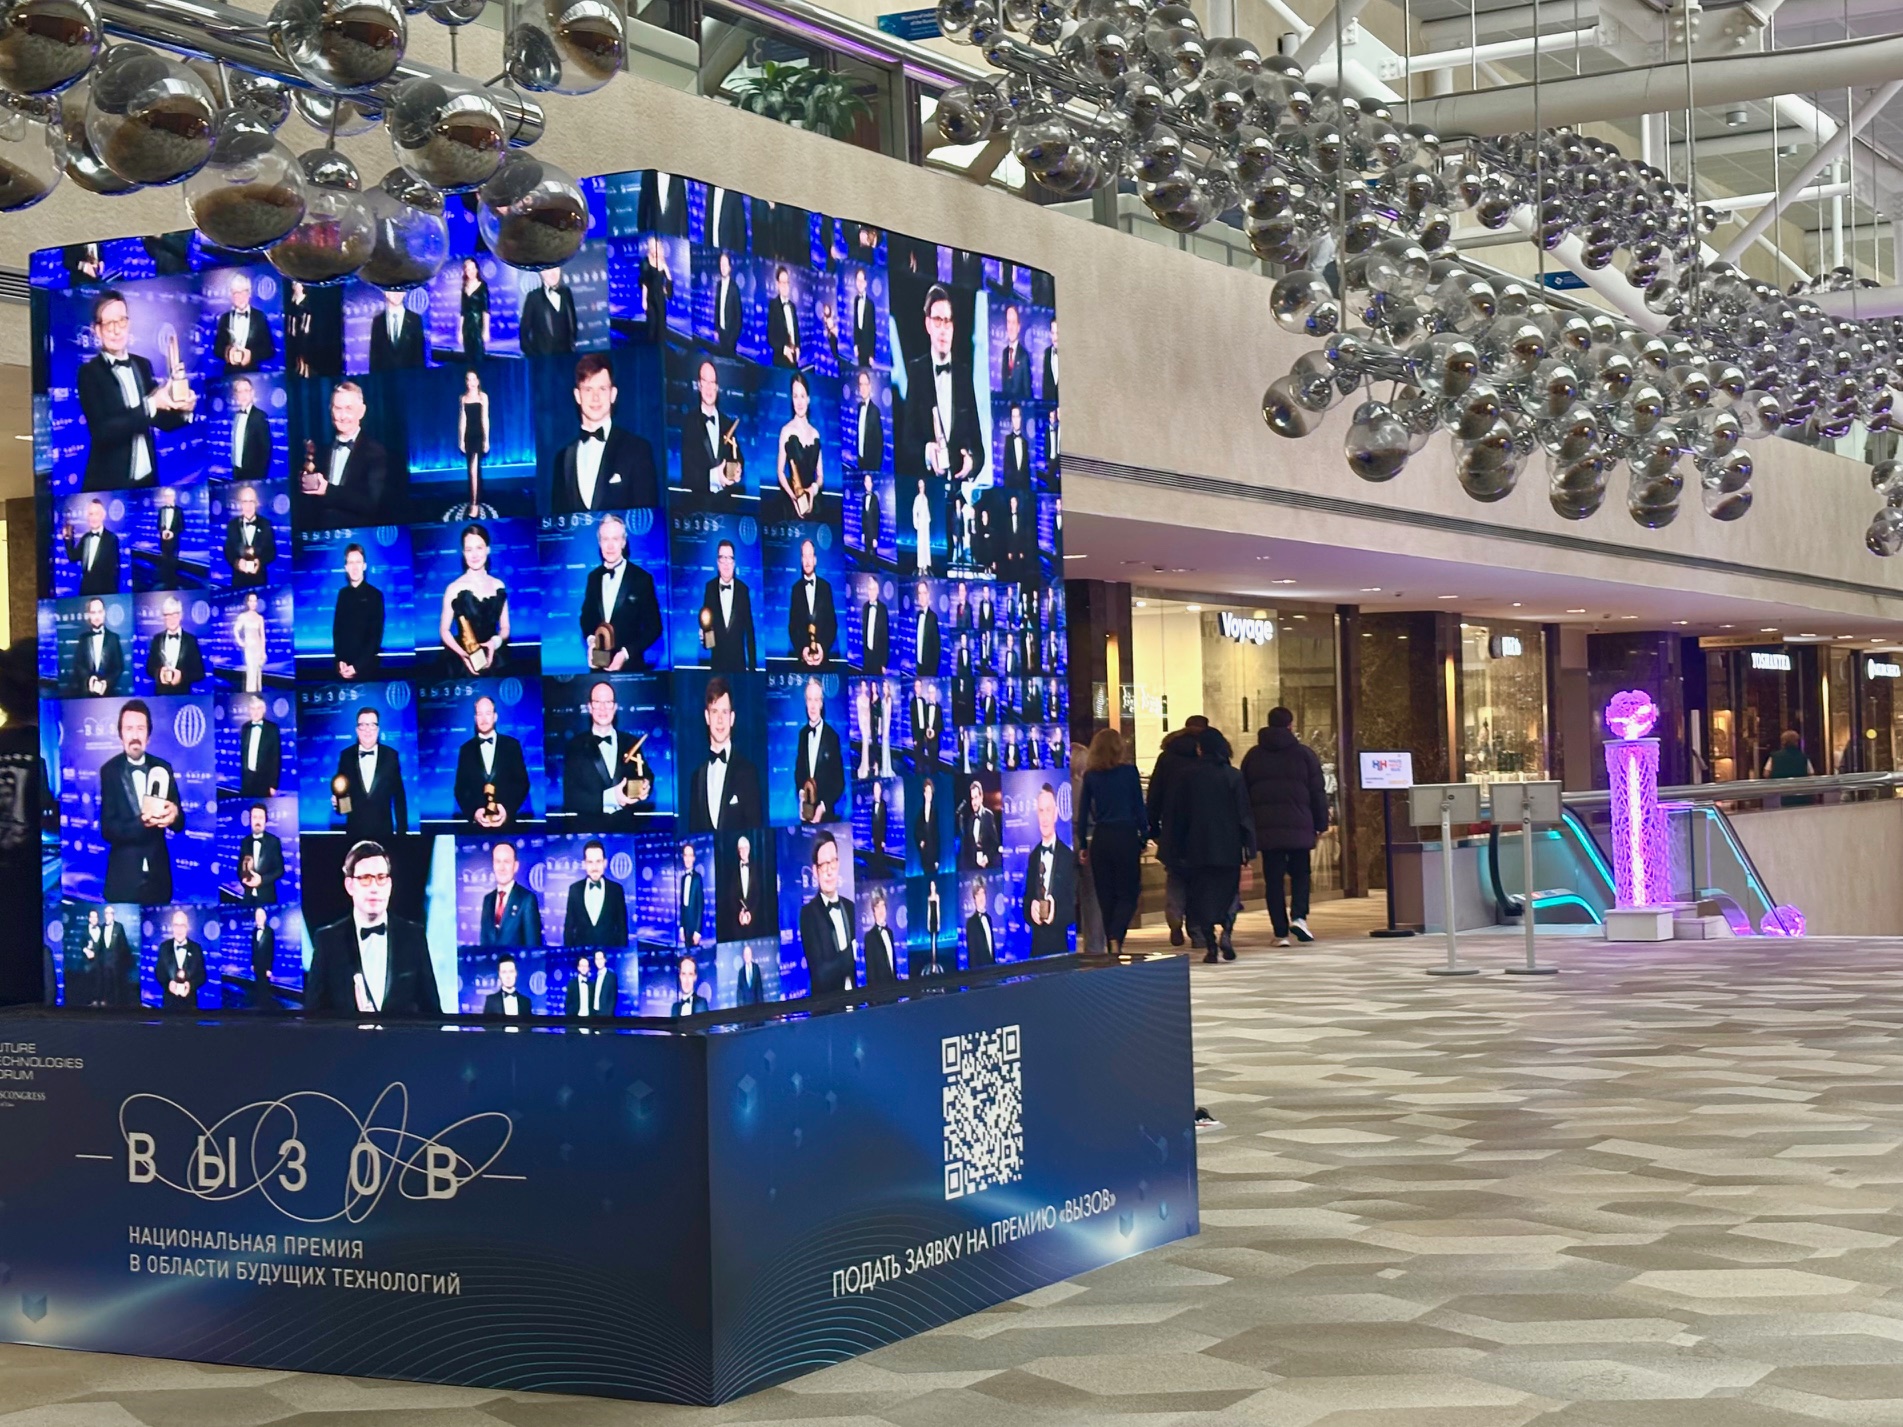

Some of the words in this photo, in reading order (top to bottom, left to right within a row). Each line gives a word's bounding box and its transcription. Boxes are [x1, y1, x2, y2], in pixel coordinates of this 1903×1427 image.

[1220, 611, 1274, 646] Voyage
[128, 1132, 458, 1199] ВЫЗОВ
[128, 1225, 277, 1254] НАЦИОНАЛЬНАЯ
[284, 1236, 364, 1259] ПРЕМИЯ
[832, 1254, 901, 1298] ПОДАТЬ
[905, 1233, 963, 1275] ЗАЯВКУ
[966, 1226, 989, 1255] НА
[991, 1205, 1057, 1247] ПРЕМИЮ
[1058, 1188, 1117, 1224] «ВЫЗОВ»
[129, 1253, 141, 1272] В
[147, 1254, 230, 1279] ОБЛАСТИ
[236, 1261, 326, 1288] БУДУЩИХ
[332, 1267, 461, 1296] ТЕХНОЛОГИЙ
